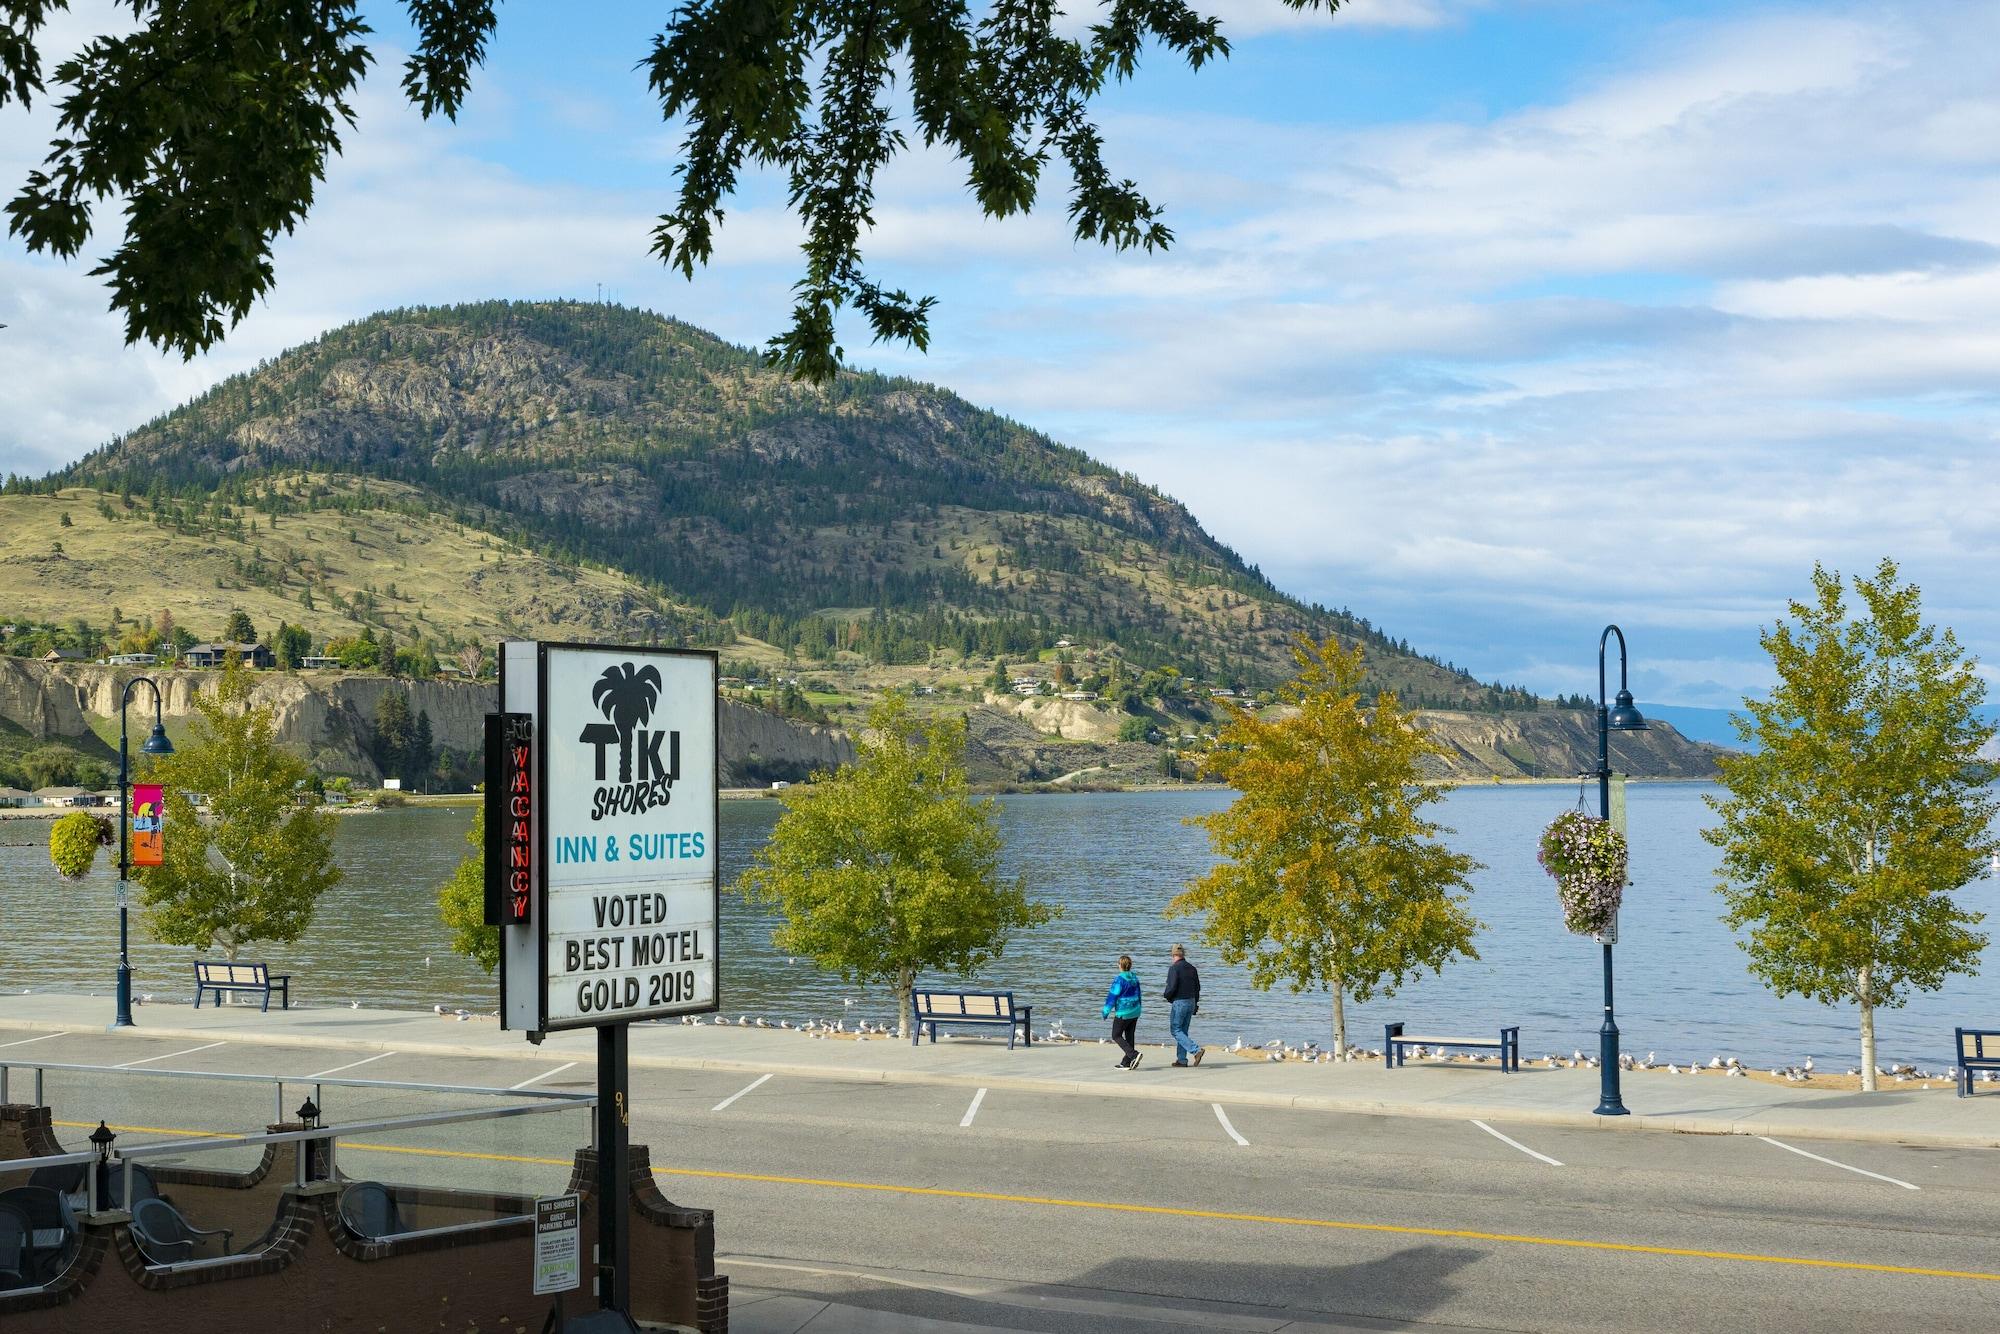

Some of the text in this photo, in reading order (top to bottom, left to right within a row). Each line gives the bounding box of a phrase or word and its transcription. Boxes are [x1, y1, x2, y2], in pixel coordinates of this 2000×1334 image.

[579, 723, 680, 783] TIKI
[591, 773, 673, 820] SHORES
[512, 746, 530, 918] VACANCY
[556, 831, 705, 864] INN & SUITES
[593, 892, 667, 928] VOTED
[566, 930, 704, 972] BEST MOTEL
[577, 970, 695, 1013] GOLD 2019
[615, 1091, 629, 1127] 914
[540, 1200, 575, 1211] TIKI SHORES
[550, 1213, 566, 1221] GUEST
[539, 1219, 575, 1231] PARKING ONLY
